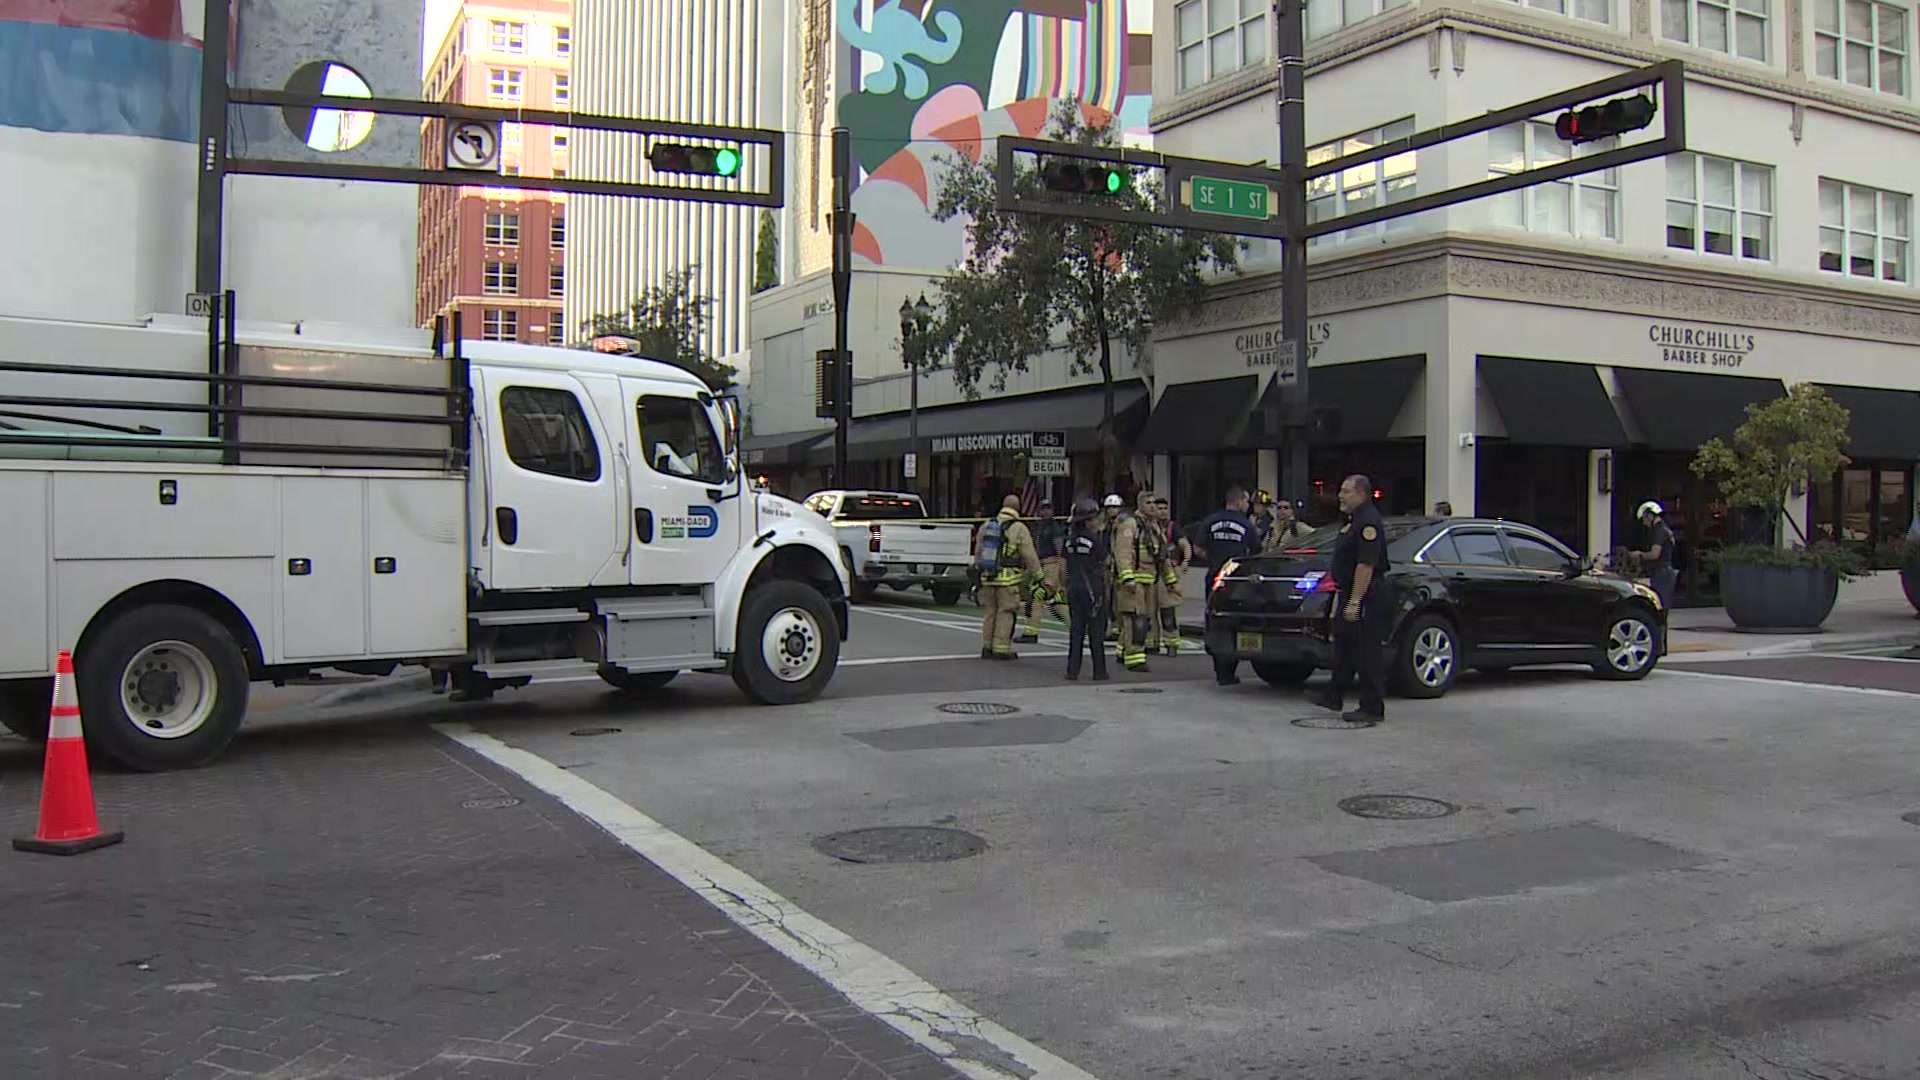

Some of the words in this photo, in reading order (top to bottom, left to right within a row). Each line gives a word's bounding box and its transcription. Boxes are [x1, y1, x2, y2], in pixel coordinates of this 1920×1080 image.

[1200, 185, 1215, 205] SE
[1228, 187, 1233, 209] 1
[1248, 191, 1262, 209] ST
[192, 298, 212, 312] ON
[1235, 322, 1330, 352] CHURCL'S
[1649, 324, 1754, 351] CHURCHILL'S
[1247, 351, 1279, 368] BARBE
[1663, 348, 1706, 364] BARBER
[1711, 352, 1743, 367] SHOP
[932, 436, 956, 453] MIAMI
[958, 433, 1003, 451] DISCOUNT
[1005, 431, 1032, 450] CENT
[1034, 461, 1065, 472] BEGIN
[661, 516, 708, 526] MIAMI-DADE
